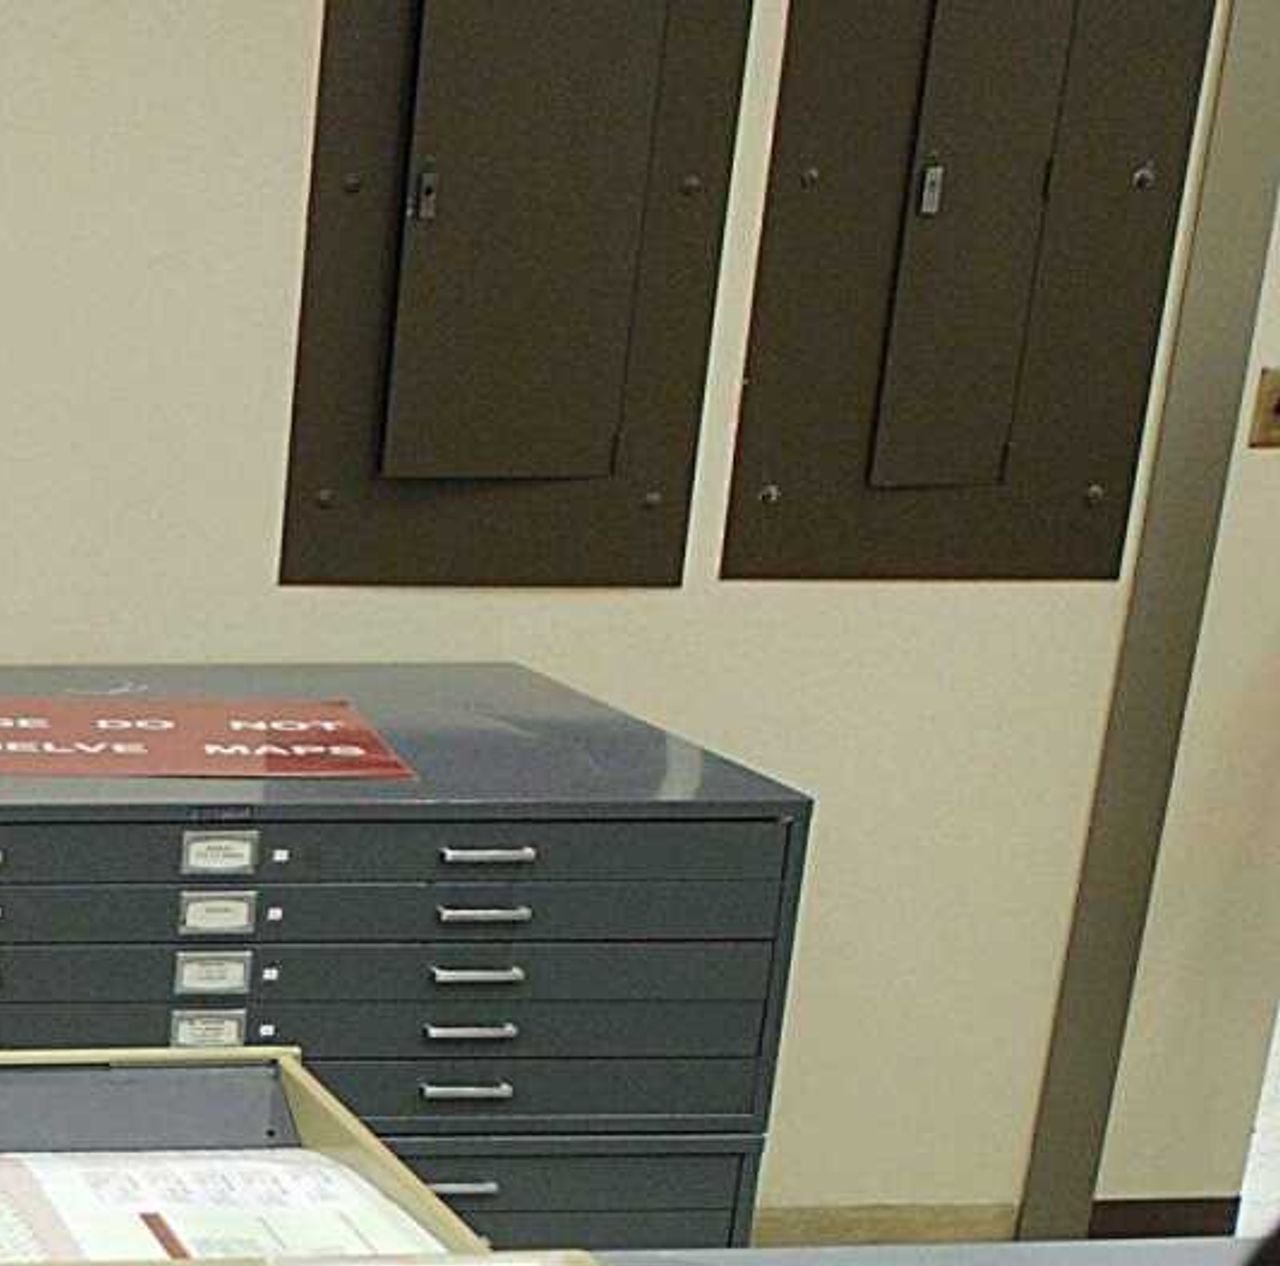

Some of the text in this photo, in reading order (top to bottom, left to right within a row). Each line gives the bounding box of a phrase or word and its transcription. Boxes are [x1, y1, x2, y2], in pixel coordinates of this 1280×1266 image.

[95, 718, 174, 731] DO
[230, 719, 344, 732] NOT
[204, 743, 364, 756] MAPS
